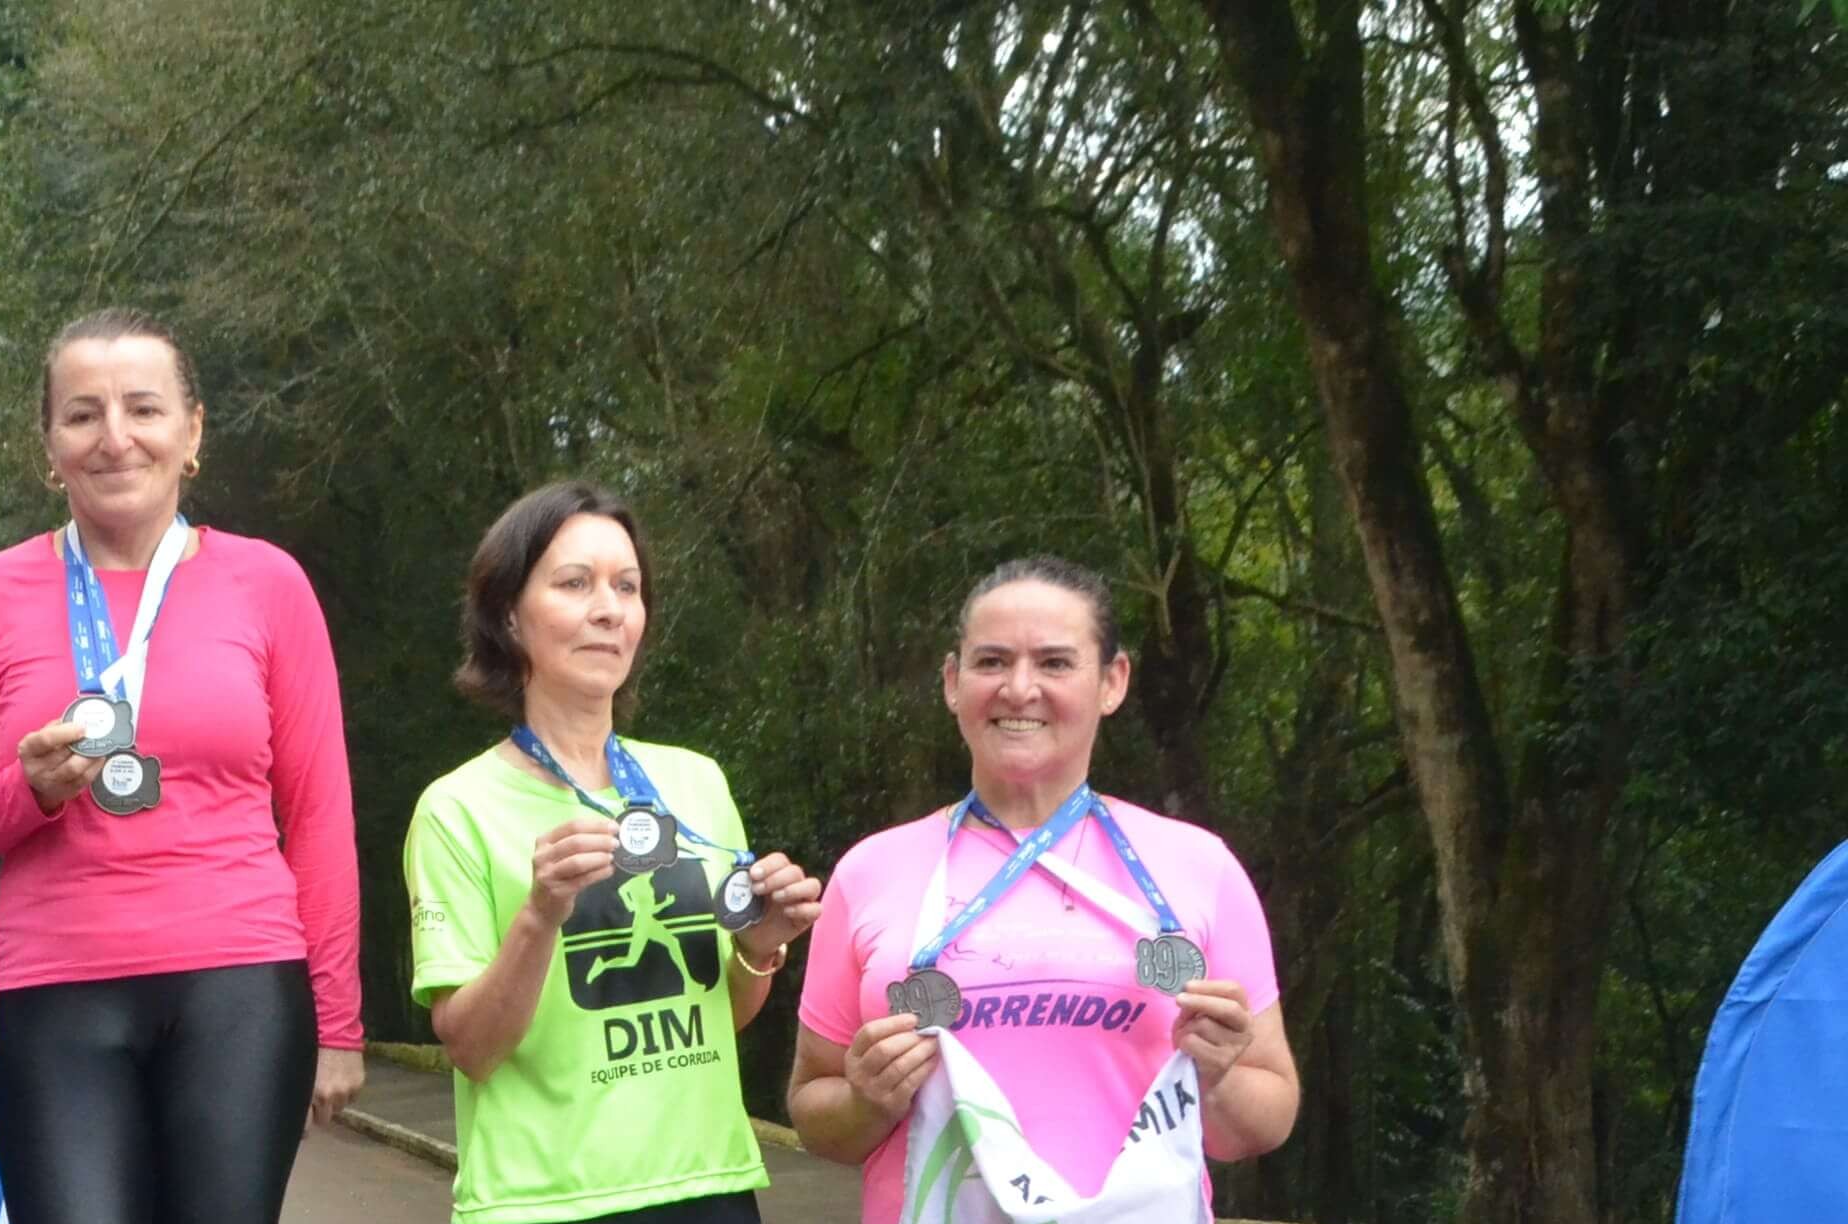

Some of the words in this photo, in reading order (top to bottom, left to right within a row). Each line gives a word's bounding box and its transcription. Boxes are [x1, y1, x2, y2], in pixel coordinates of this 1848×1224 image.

[604, 1004, 704, 1062] DIM
[949, 993, 1146, 1033] ORRENDO!
[591, 1064, 638, 1084] EQUIPE
[642, 1059, 663, 1074] DE
[667, 1050, 721, 1069] CORRIDA
